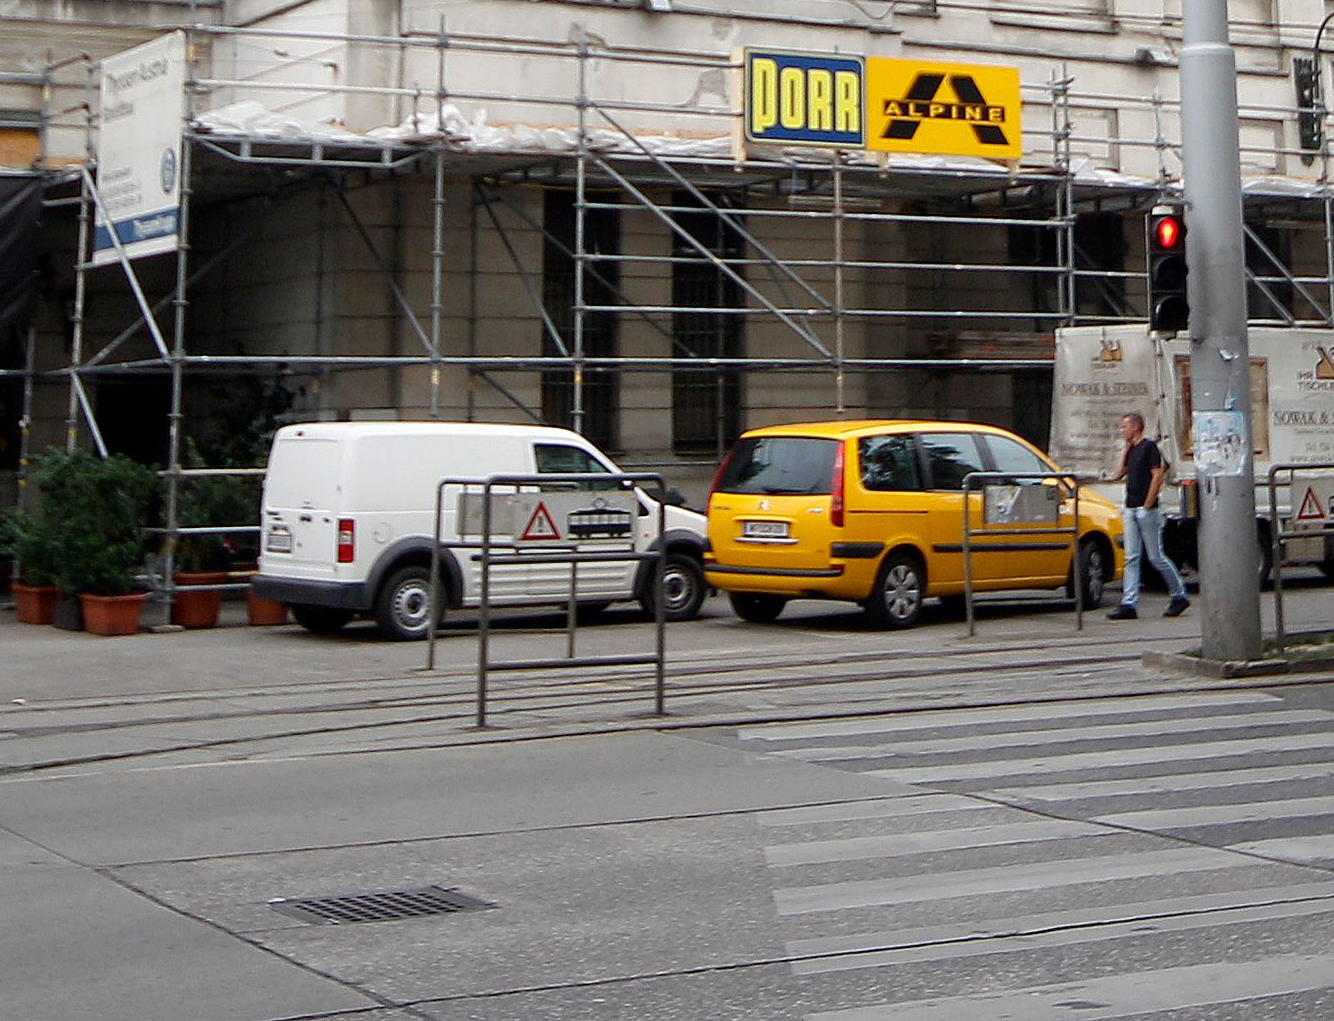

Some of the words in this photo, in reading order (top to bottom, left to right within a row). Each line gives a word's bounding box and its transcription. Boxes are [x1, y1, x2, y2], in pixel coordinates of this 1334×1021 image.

[752, 58, 860, 134] PORR
[884, 100, 1005, 123] ALPINE
[1274, 410, 1318, 426] NOWAK
